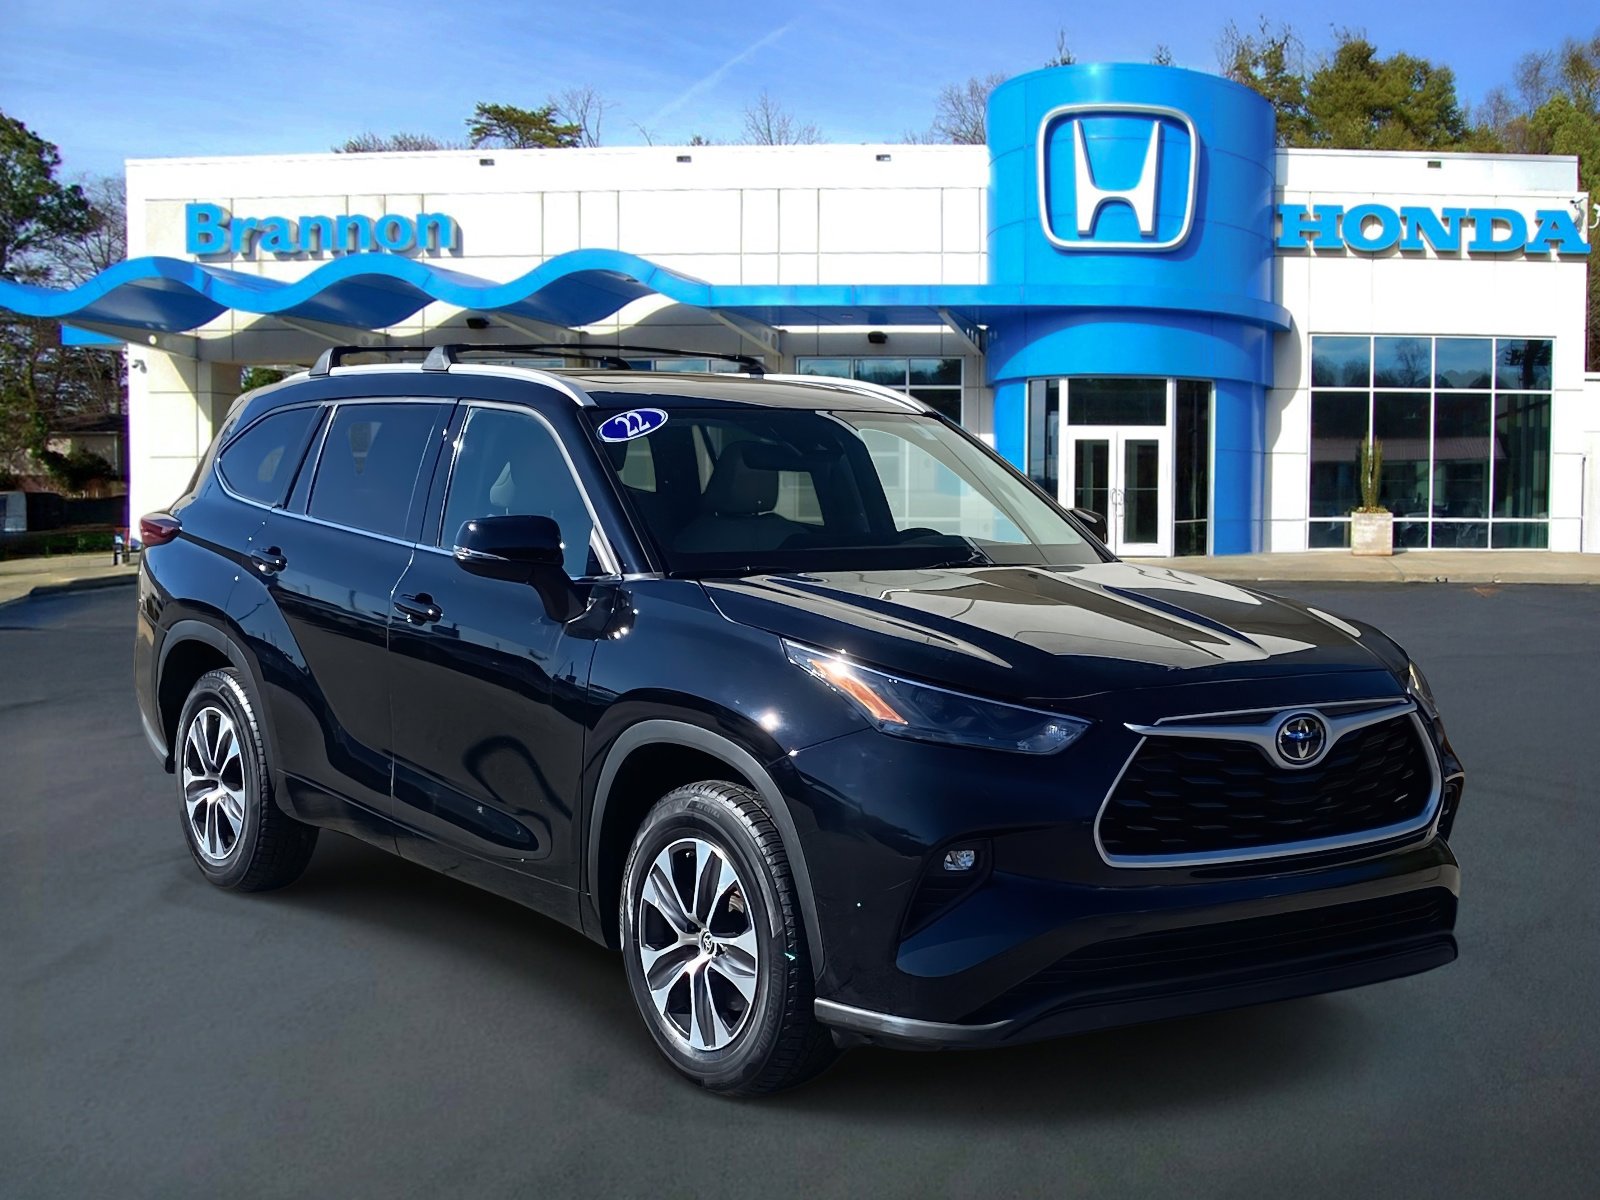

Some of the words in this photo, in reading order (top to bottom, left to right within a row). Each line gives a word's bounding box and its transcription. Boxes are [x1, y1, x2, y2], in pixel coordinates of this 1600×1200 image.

[185, 202, 456, 255] Brannon
[1277, 203, 1591, 254] HONDA
[614, 412, 651, 437] 22
